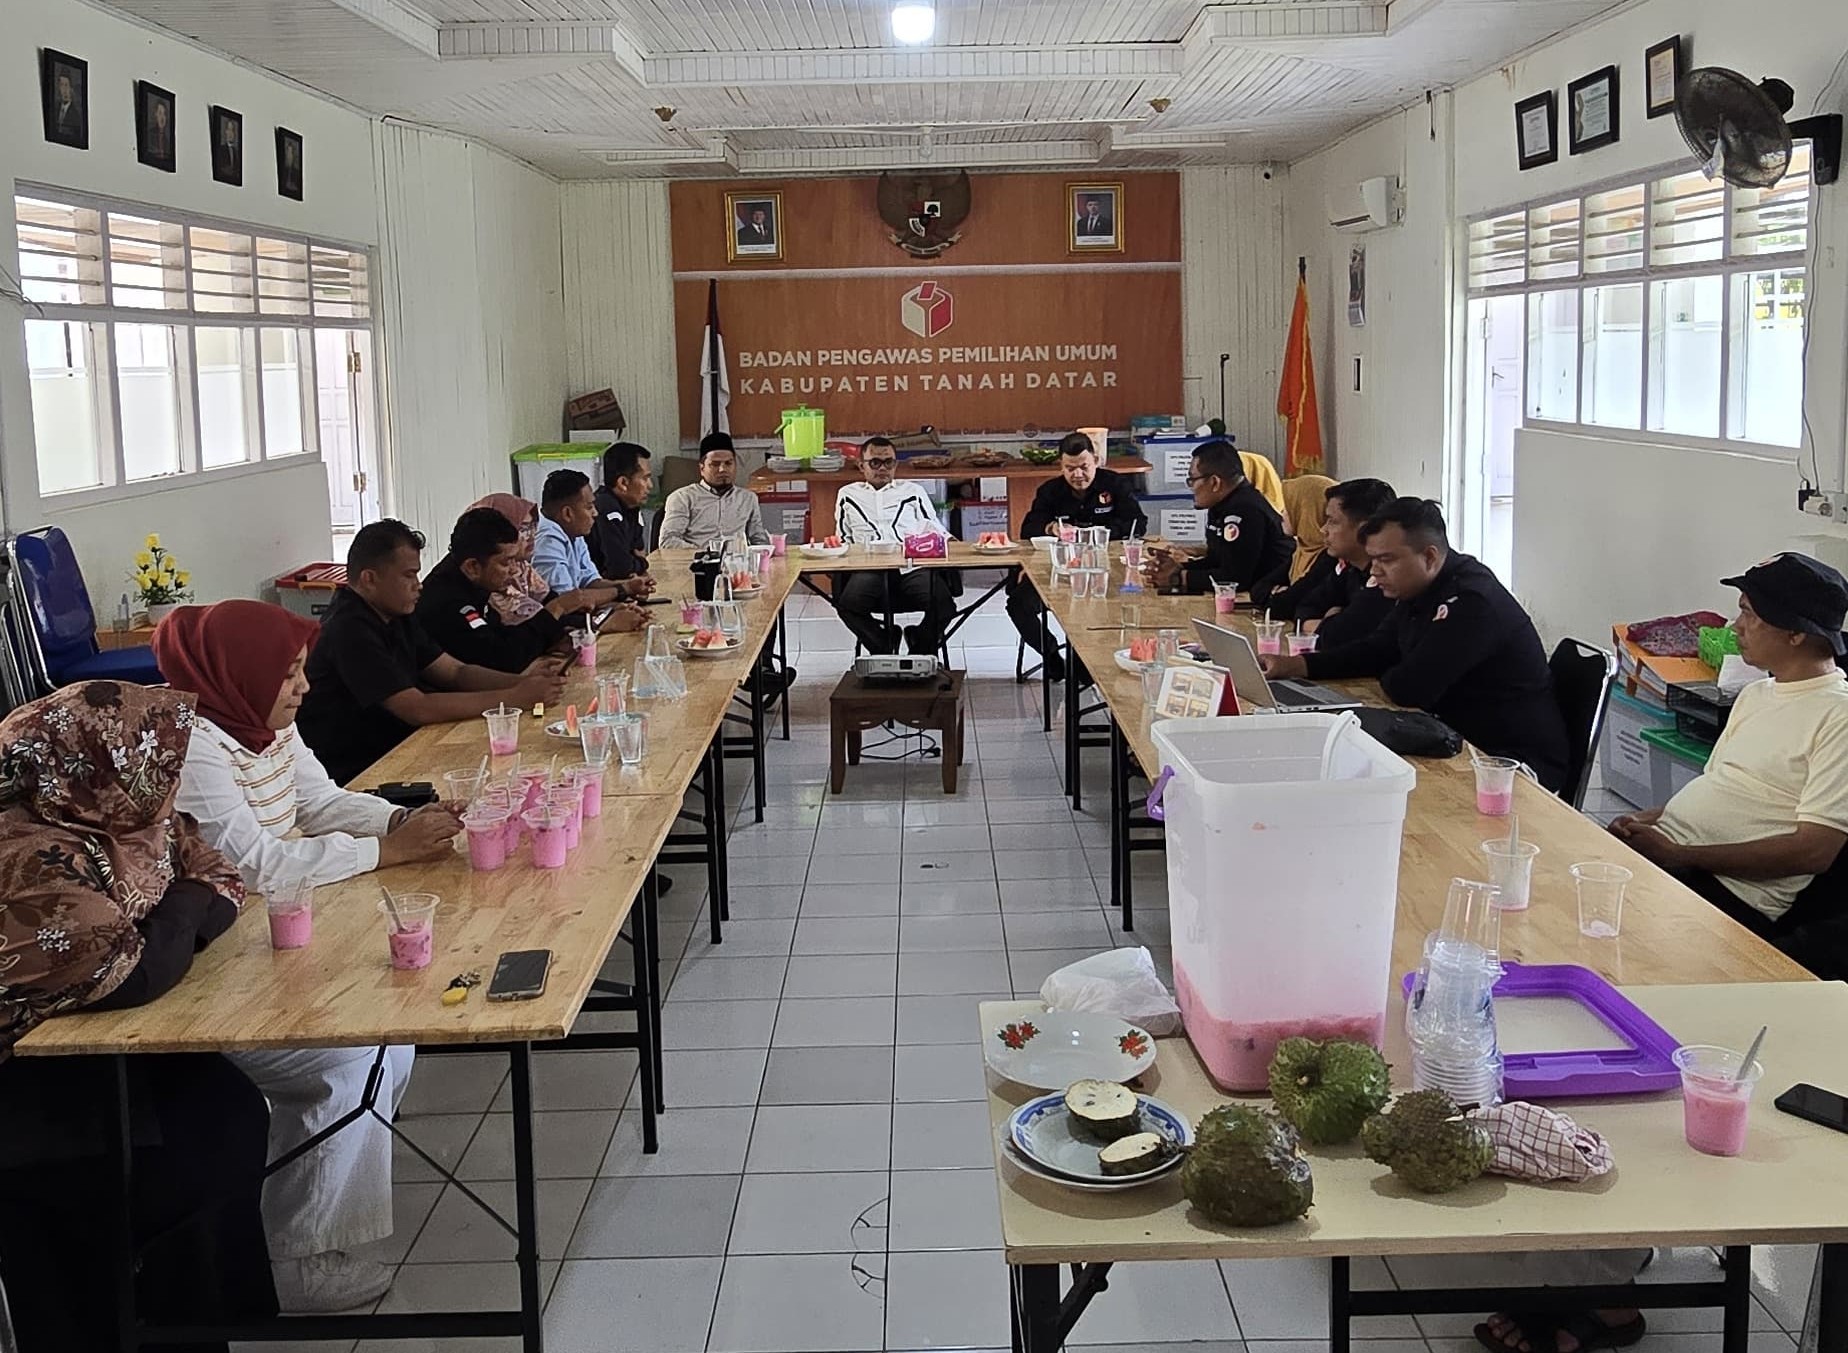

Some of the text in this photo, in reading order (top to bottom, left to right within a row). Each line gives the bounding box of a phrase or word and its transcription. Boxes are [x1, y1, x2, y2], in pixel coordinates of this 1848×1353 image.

[739, 344, 1117, 368] BADAN PENGAWAS PEMILIHAN UMUM
[740, 371, 1117, 394] KABUPATEN TANAH DATAR
